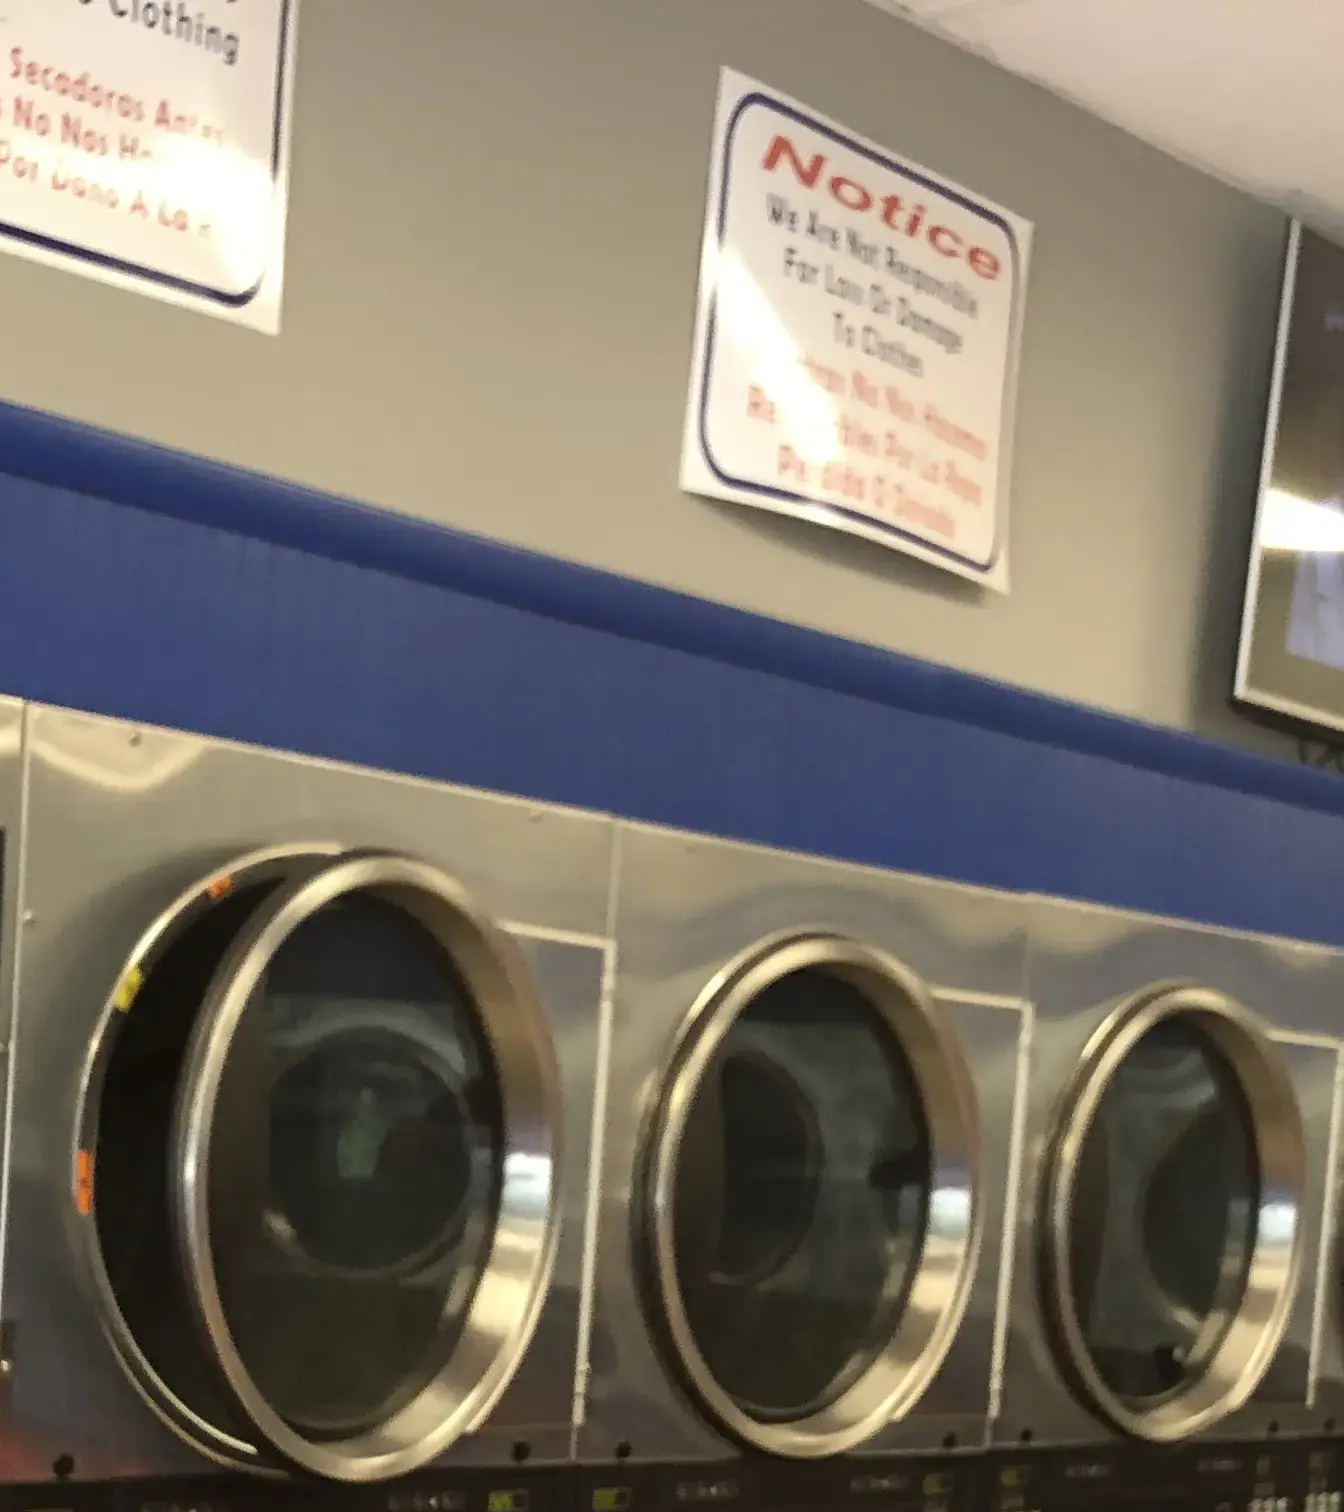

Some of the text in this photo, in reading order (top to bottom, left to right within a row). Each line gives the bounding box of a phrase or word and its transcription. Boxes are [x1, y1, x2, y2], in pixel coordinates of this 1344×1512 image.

[110, 0, 239, 66] Clothing
[10, 46, 146, 121] Secadoras
[14, 96, 51, 136] No
[61, 112, 109, 157] Nos
[762, 134, 1002, 281] Notice
